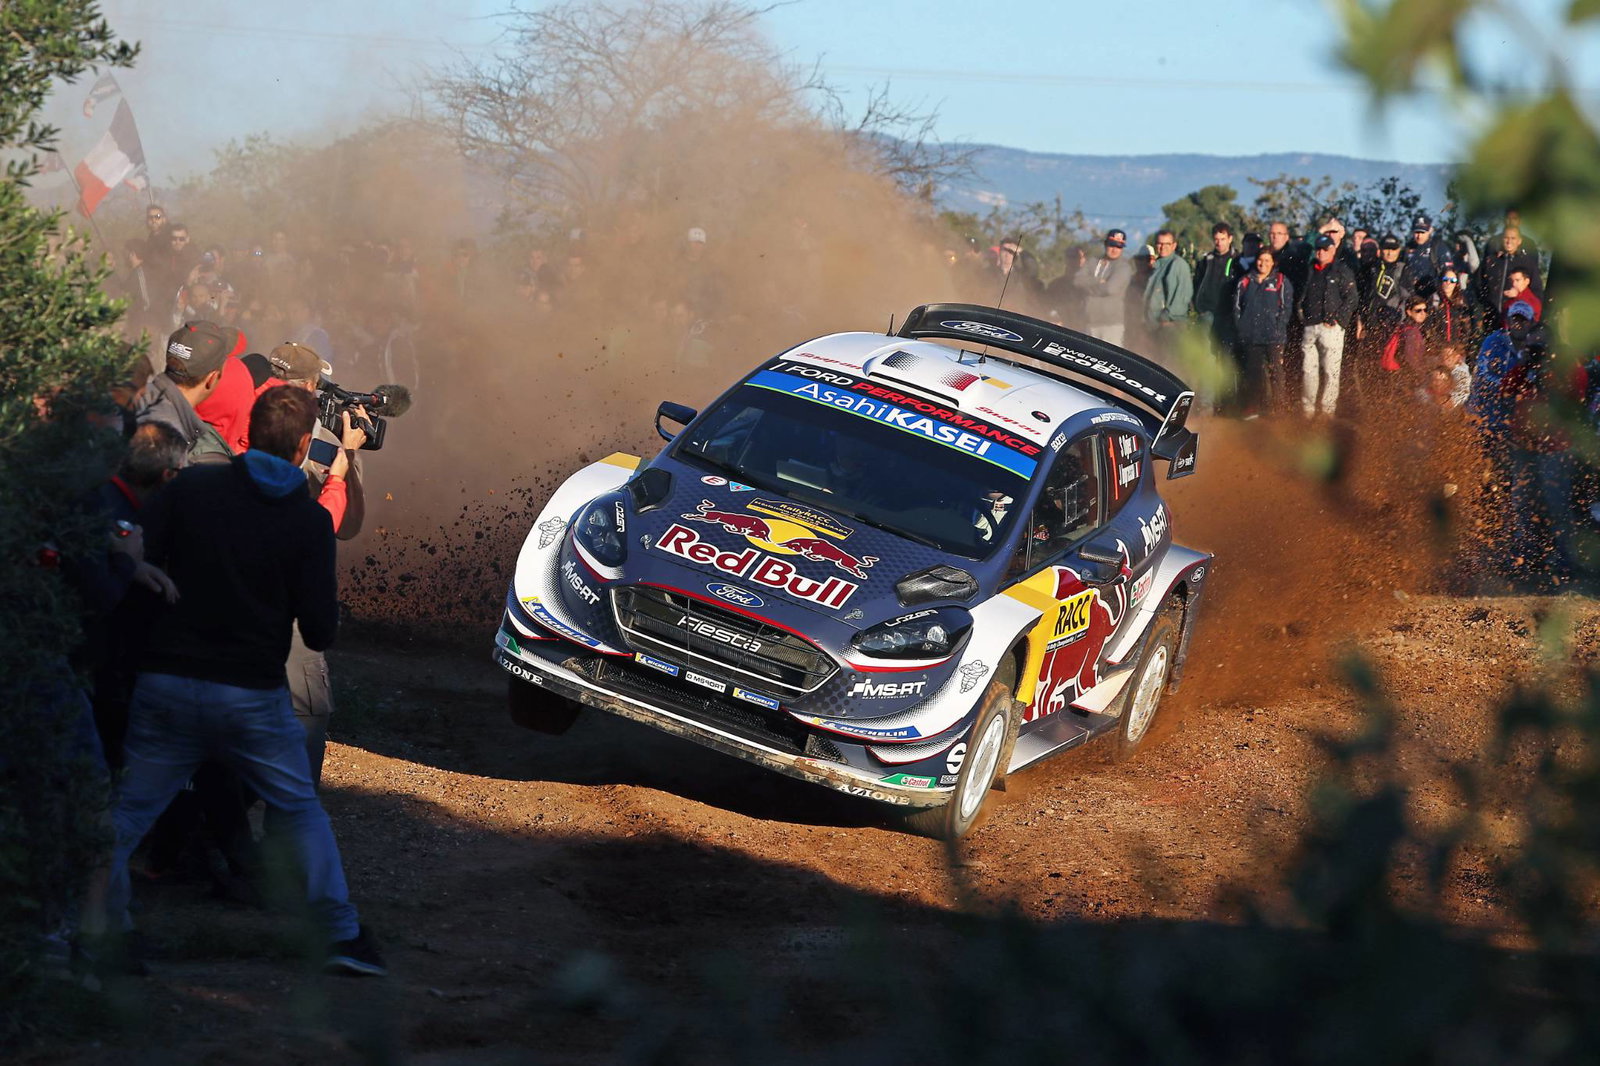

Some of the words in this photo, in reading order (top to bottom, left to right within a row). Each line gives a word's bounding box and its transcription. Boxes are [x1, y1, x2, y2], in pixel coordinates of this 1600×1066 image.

[956, 321, 1015, 340] Ford
[1048, 342, 1107, 372] Powered
[1106, 361, 1126, 374] by
[1043, 346, 1168, 403] EcoBoost
[785, 364, 854, 386] FORD
[852, 382, 1041, 456] PERFORMANCE
[656, 523, 762, 577] Red
[750, 556, 859, 610] Bull
[715, 586, 754, 606] Ford
[1054, 594, 1091, 637] RACC
[535, 610, 591, 643] MICHELIN
[647, 659, 676, 673] MICHELIN
[862, 681, 927, 697] MS-RT
[746, 692, 776, 708] MICHELIN
[840, 725, 908, 737] MICHELIN
[907, 778, 931, 788] Castrol
[837, 784, 911, 806] AZIONE
